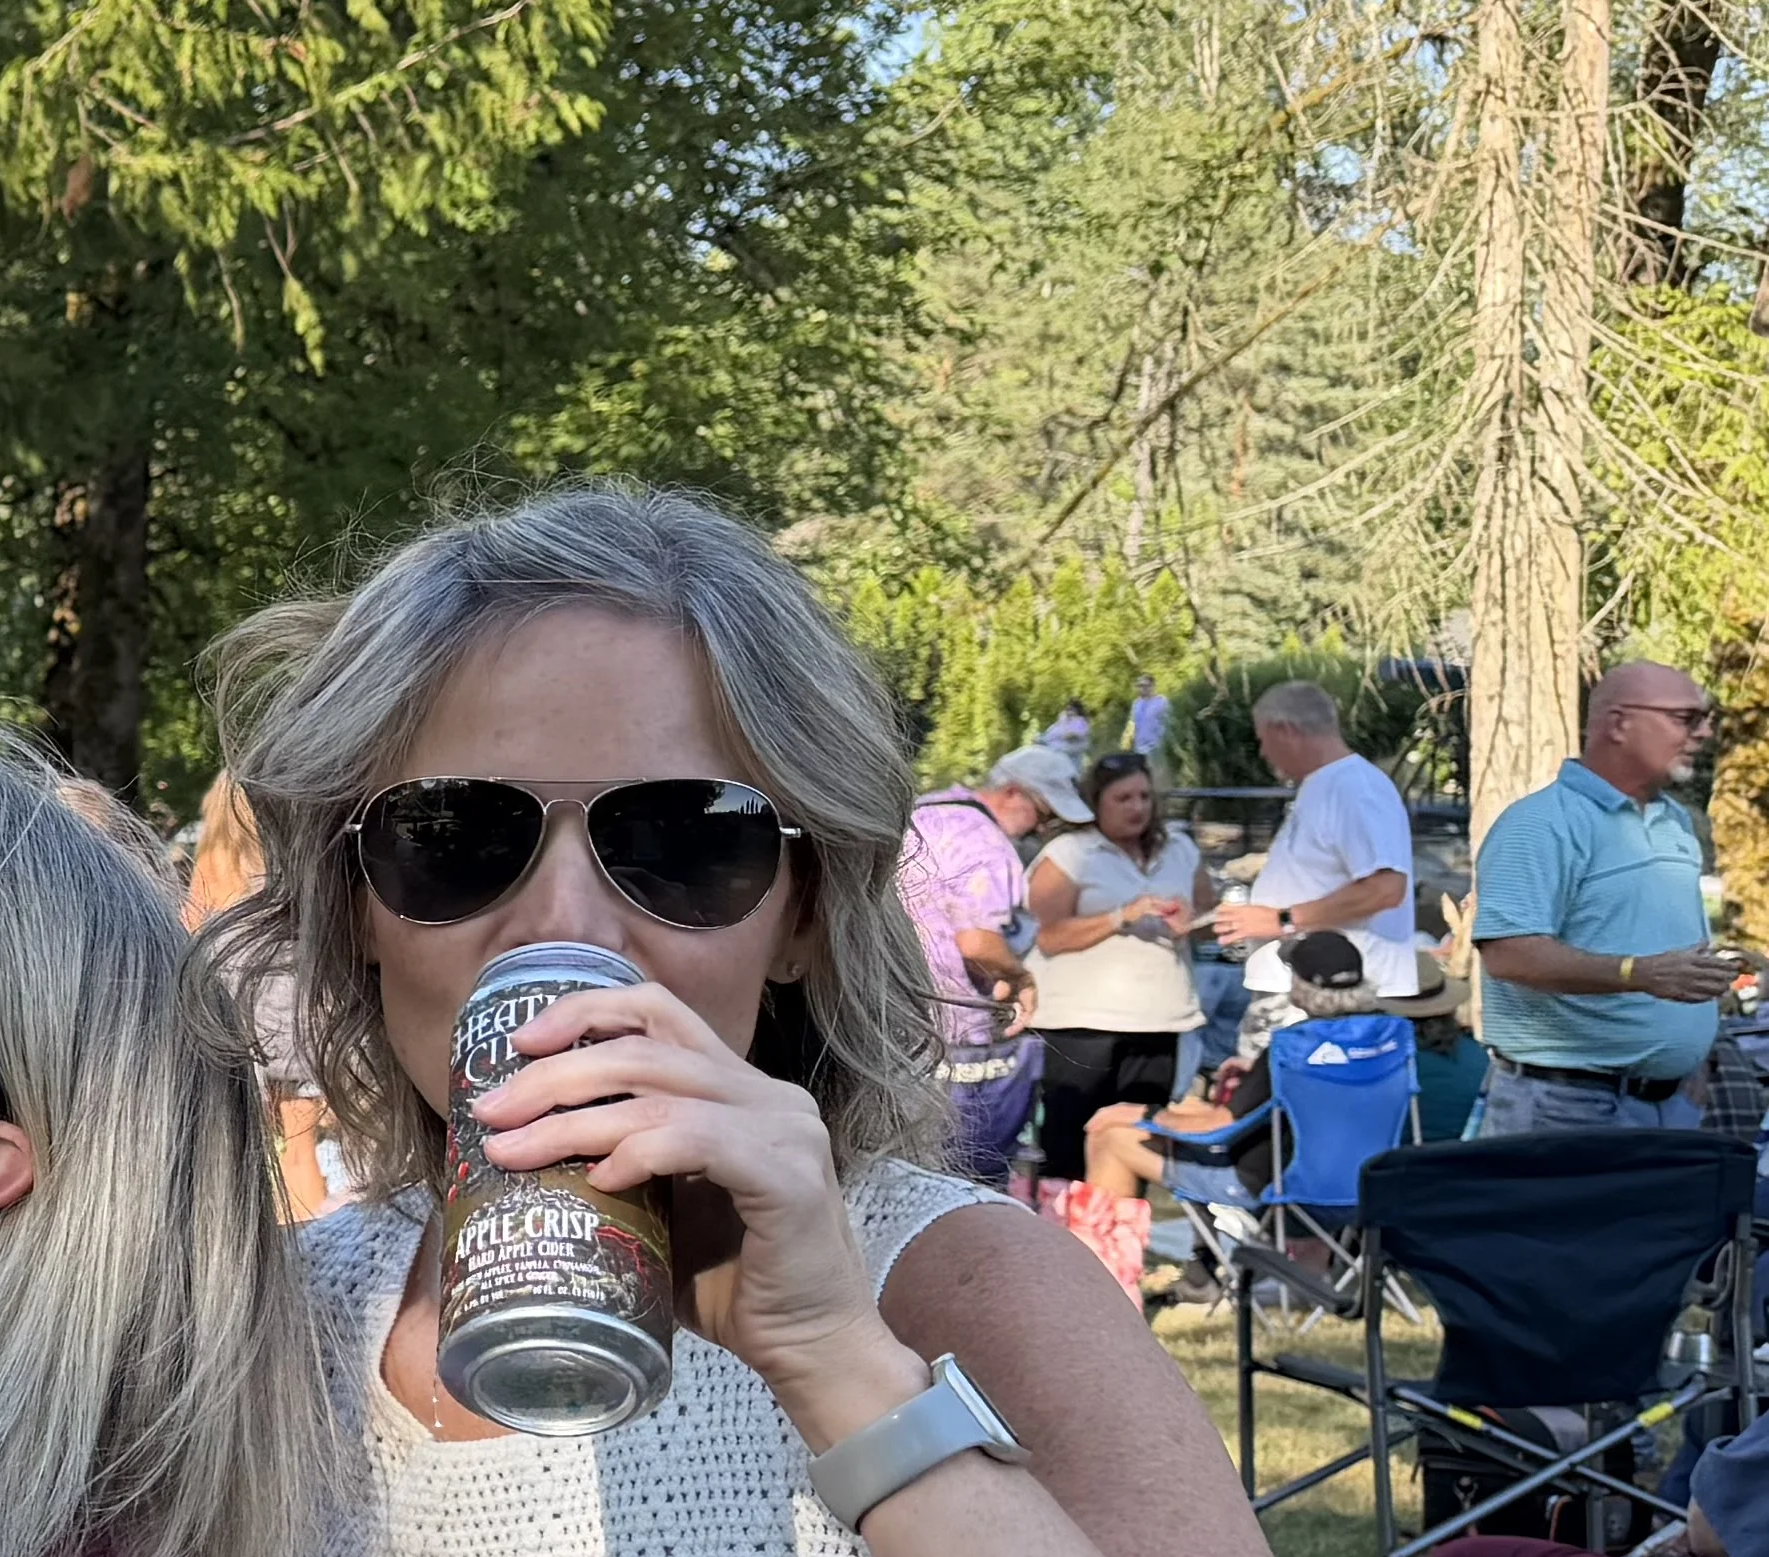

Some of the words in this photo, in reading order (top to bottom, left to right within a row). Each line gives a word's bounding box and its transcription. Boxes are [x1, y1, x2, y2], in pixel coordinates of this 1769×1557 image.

[454, 1212, 516, 1264] APPLE
[524, 1205, 600, 1242] CRISP
[468, 1250, 494, 1272] HARD
[498, 1242, 533, 1261] APPLE
[538, 1240, 574, 1257] CIDER
